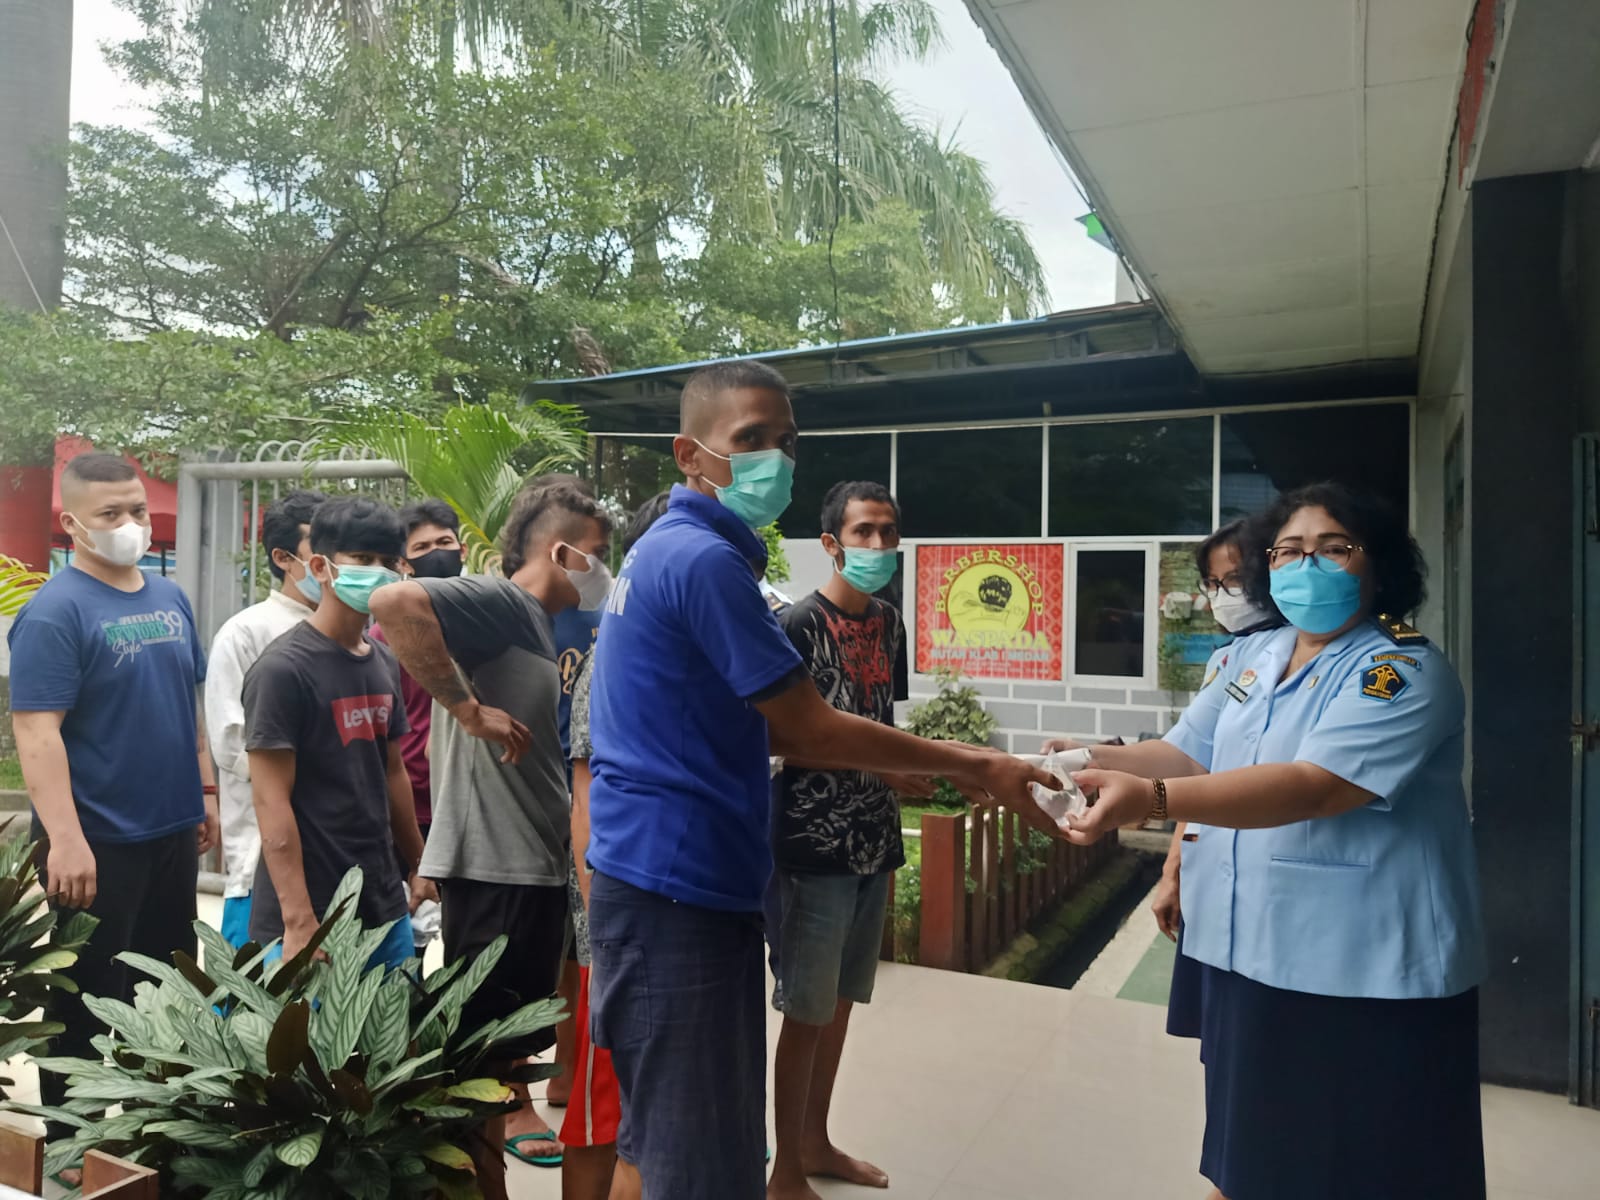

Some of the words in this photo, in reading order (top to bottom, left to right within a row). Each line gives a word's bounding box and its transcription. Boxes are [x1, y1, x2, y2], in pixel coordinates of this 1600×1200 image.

[935, 549, 1044, 616] BARBERSHOP
[154, 611, 183, 636] 39
[930, 629, 1051, 650] WASPADA
[112, 637, 143, 668] Style
[931, 649, 966, 660] RUTAN
[1008, 651, 1049, 662] MEDAN
